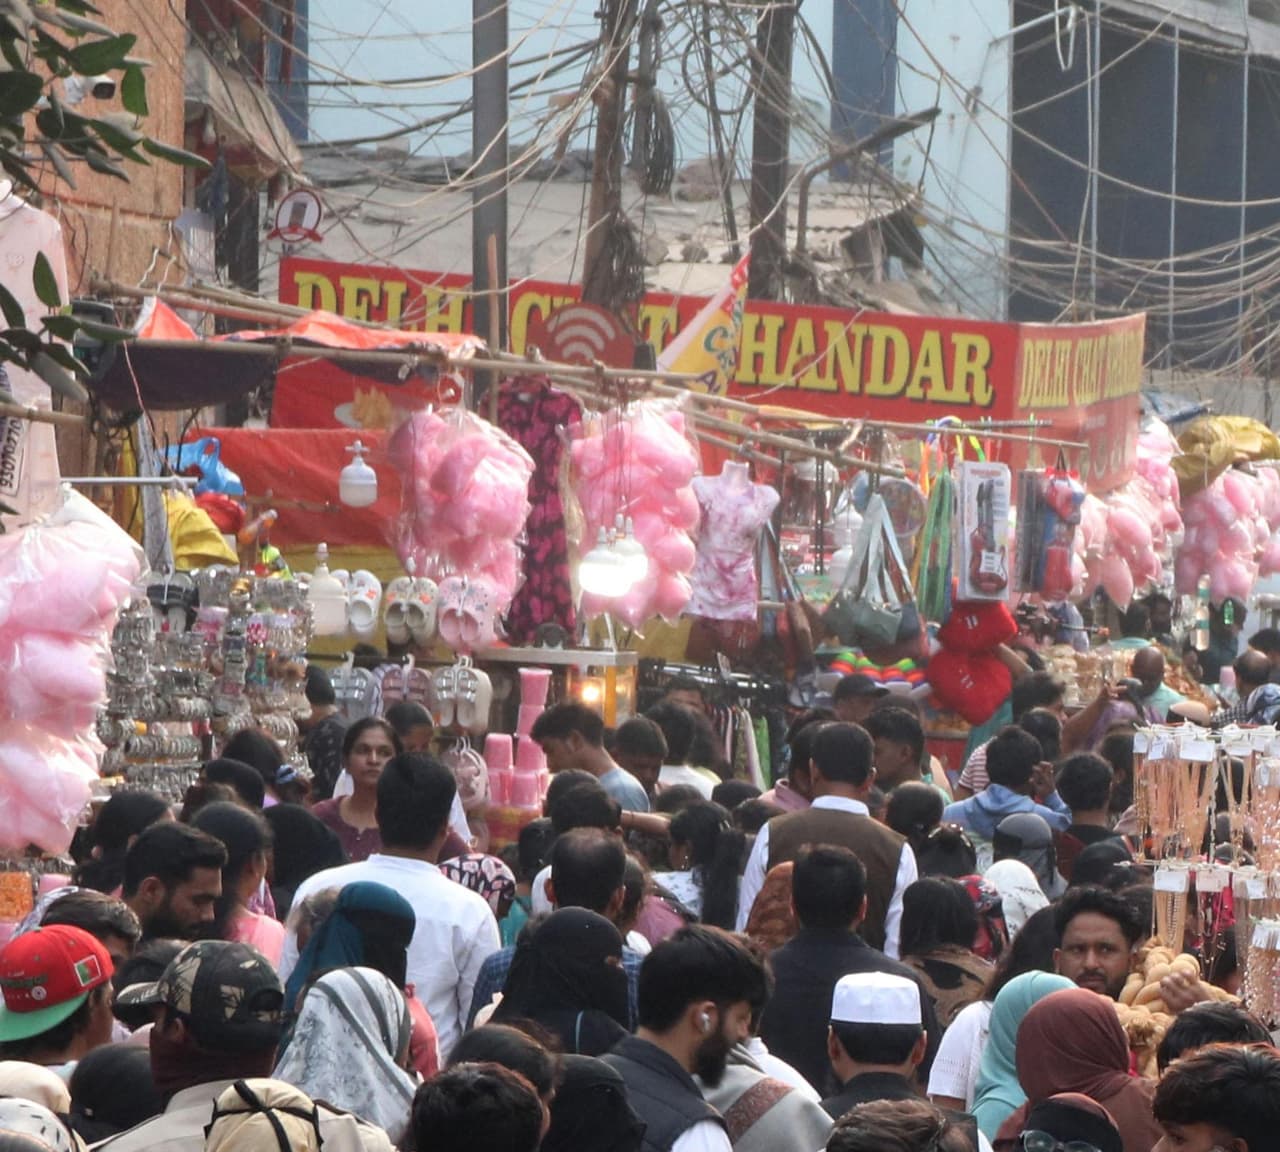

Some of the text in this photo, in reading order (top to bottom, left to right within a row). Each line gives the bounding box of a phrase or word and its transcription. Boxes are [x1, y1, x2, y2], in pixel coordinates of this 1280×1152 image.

[294, 272, 471, 333] DELH
[736, 313, 993, 406] HANDAR
[1019, 339, 1072, 408] DELHI
